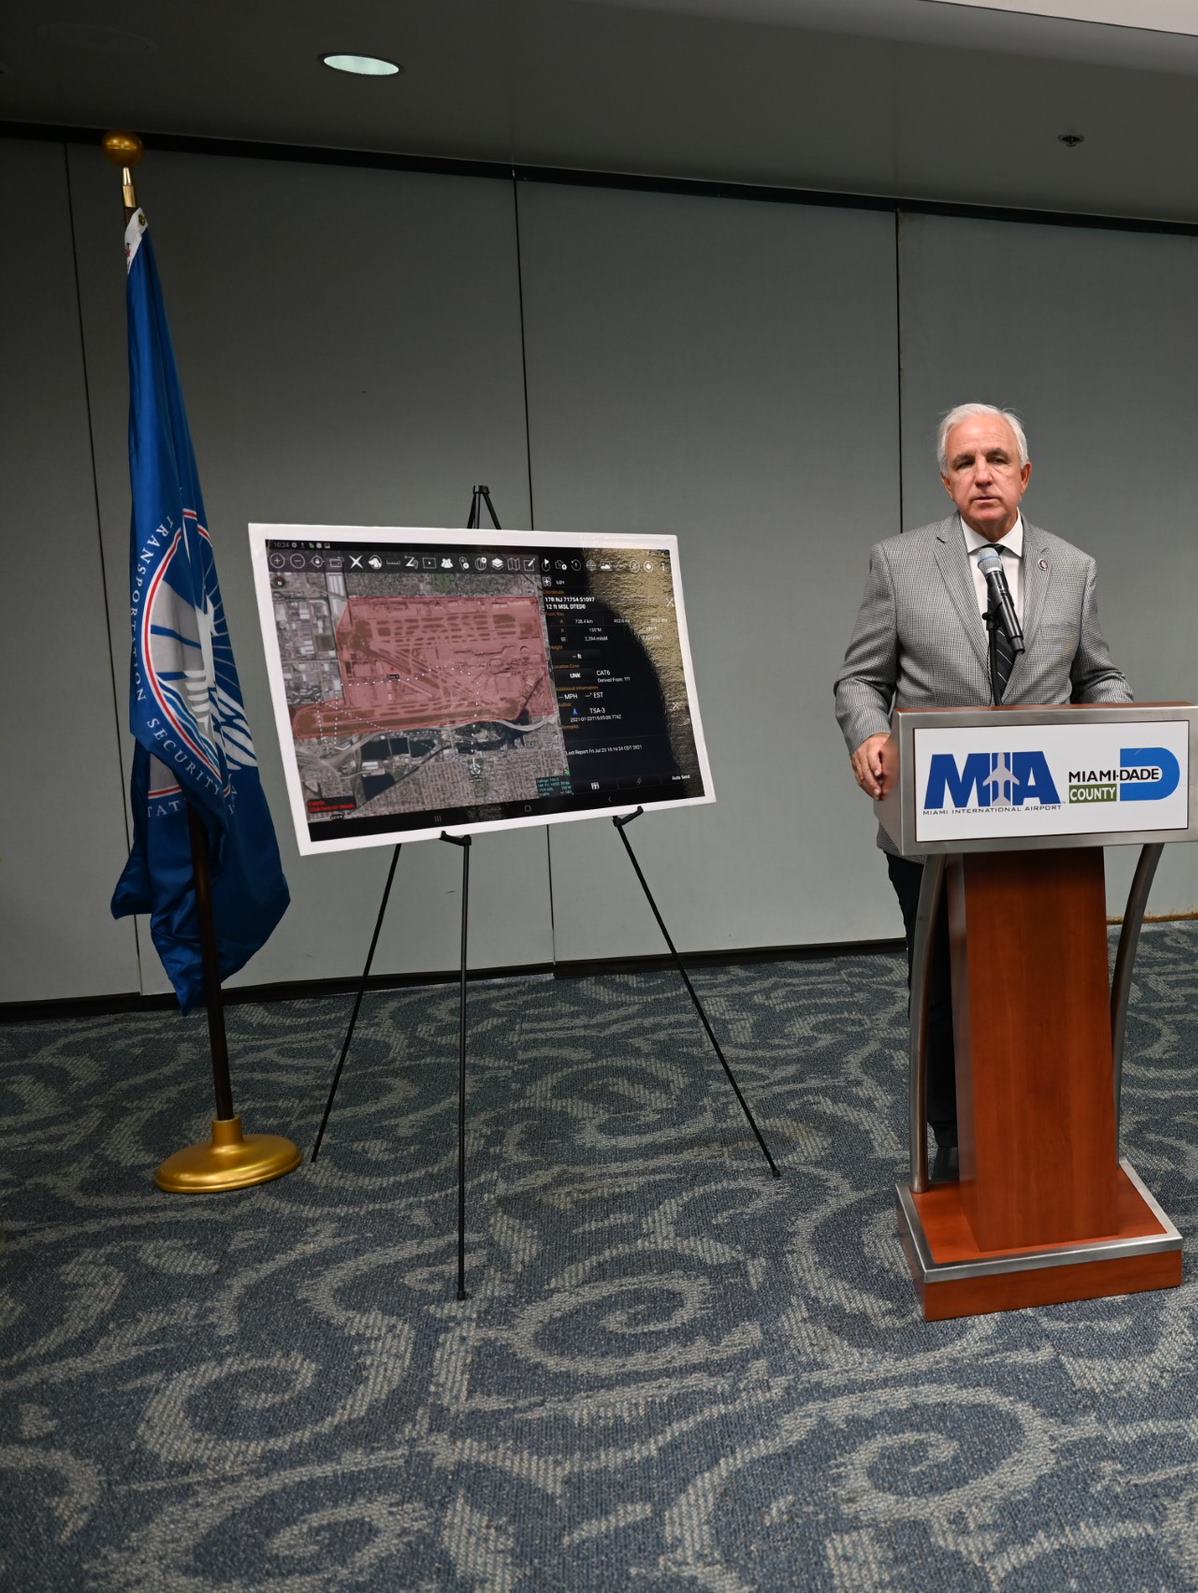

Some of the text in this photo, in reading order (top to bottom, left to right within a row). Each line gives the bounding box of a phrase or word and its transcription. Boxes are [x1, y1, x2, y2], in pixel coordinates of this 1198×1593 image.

[147, 718, 220, 795] SECURITY
[924, 751, 1061, 809] MIA
[1070, 786, 1117, 801] COUNTY
[951, 806, 1021, 815] INTERNATIONAL
[1024, 804, 1062, 812] AIRPORT
